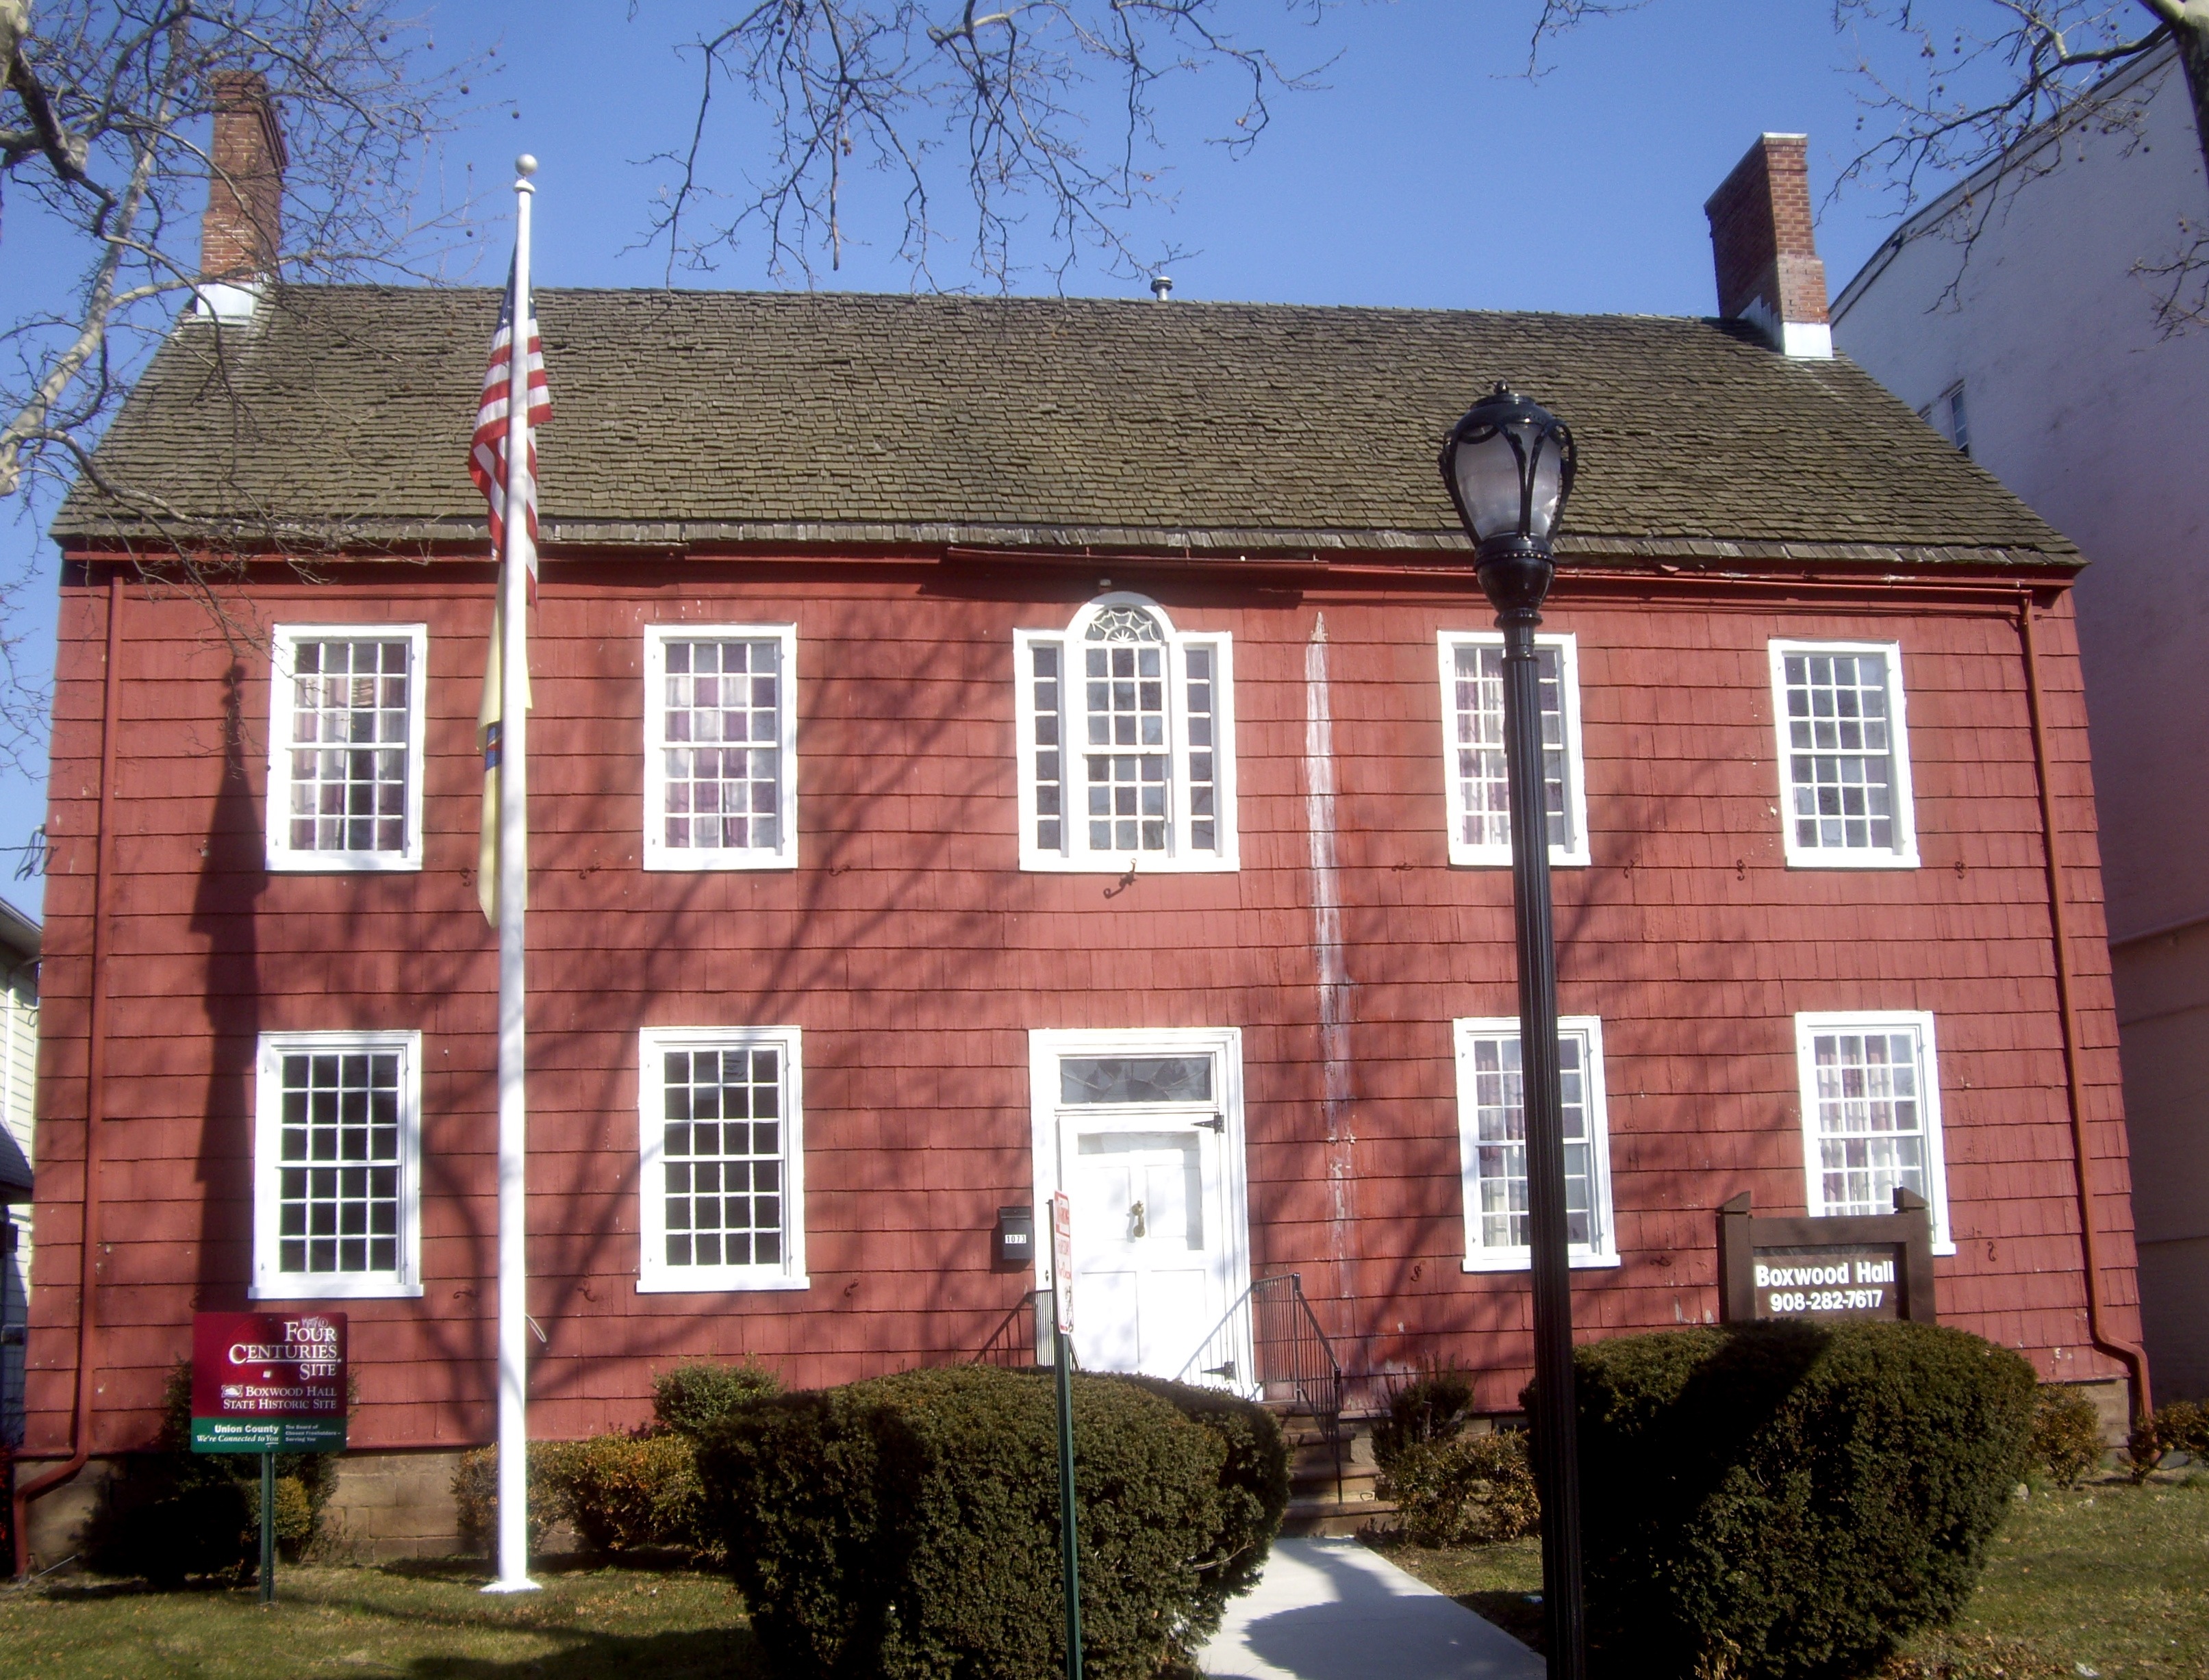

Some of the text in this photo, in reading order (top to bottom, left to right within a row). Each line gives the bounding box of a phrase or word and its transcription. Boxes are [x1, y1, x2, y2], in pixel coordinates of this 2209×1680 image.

[1007, 1235, 1026, 1243] 1073
[1755, 1260, 1895, 1287] Boxwood Hall
[1770, 1289, 1883, 1312] 908-282-7617
[283, 1321, 338, 1342] FOUR
[228, 1344, 338, 1364] CENTURIES
[299, 1363, 336, 1380] SITE
[245, 1386, 337, 1397] BOXWOOD HALL
[223, 1399, 337, 1410] STATE HISTORIC SITE
[214, 1424, 279, 1434] Union County
[218, 1434, 256, 1442] Connected
